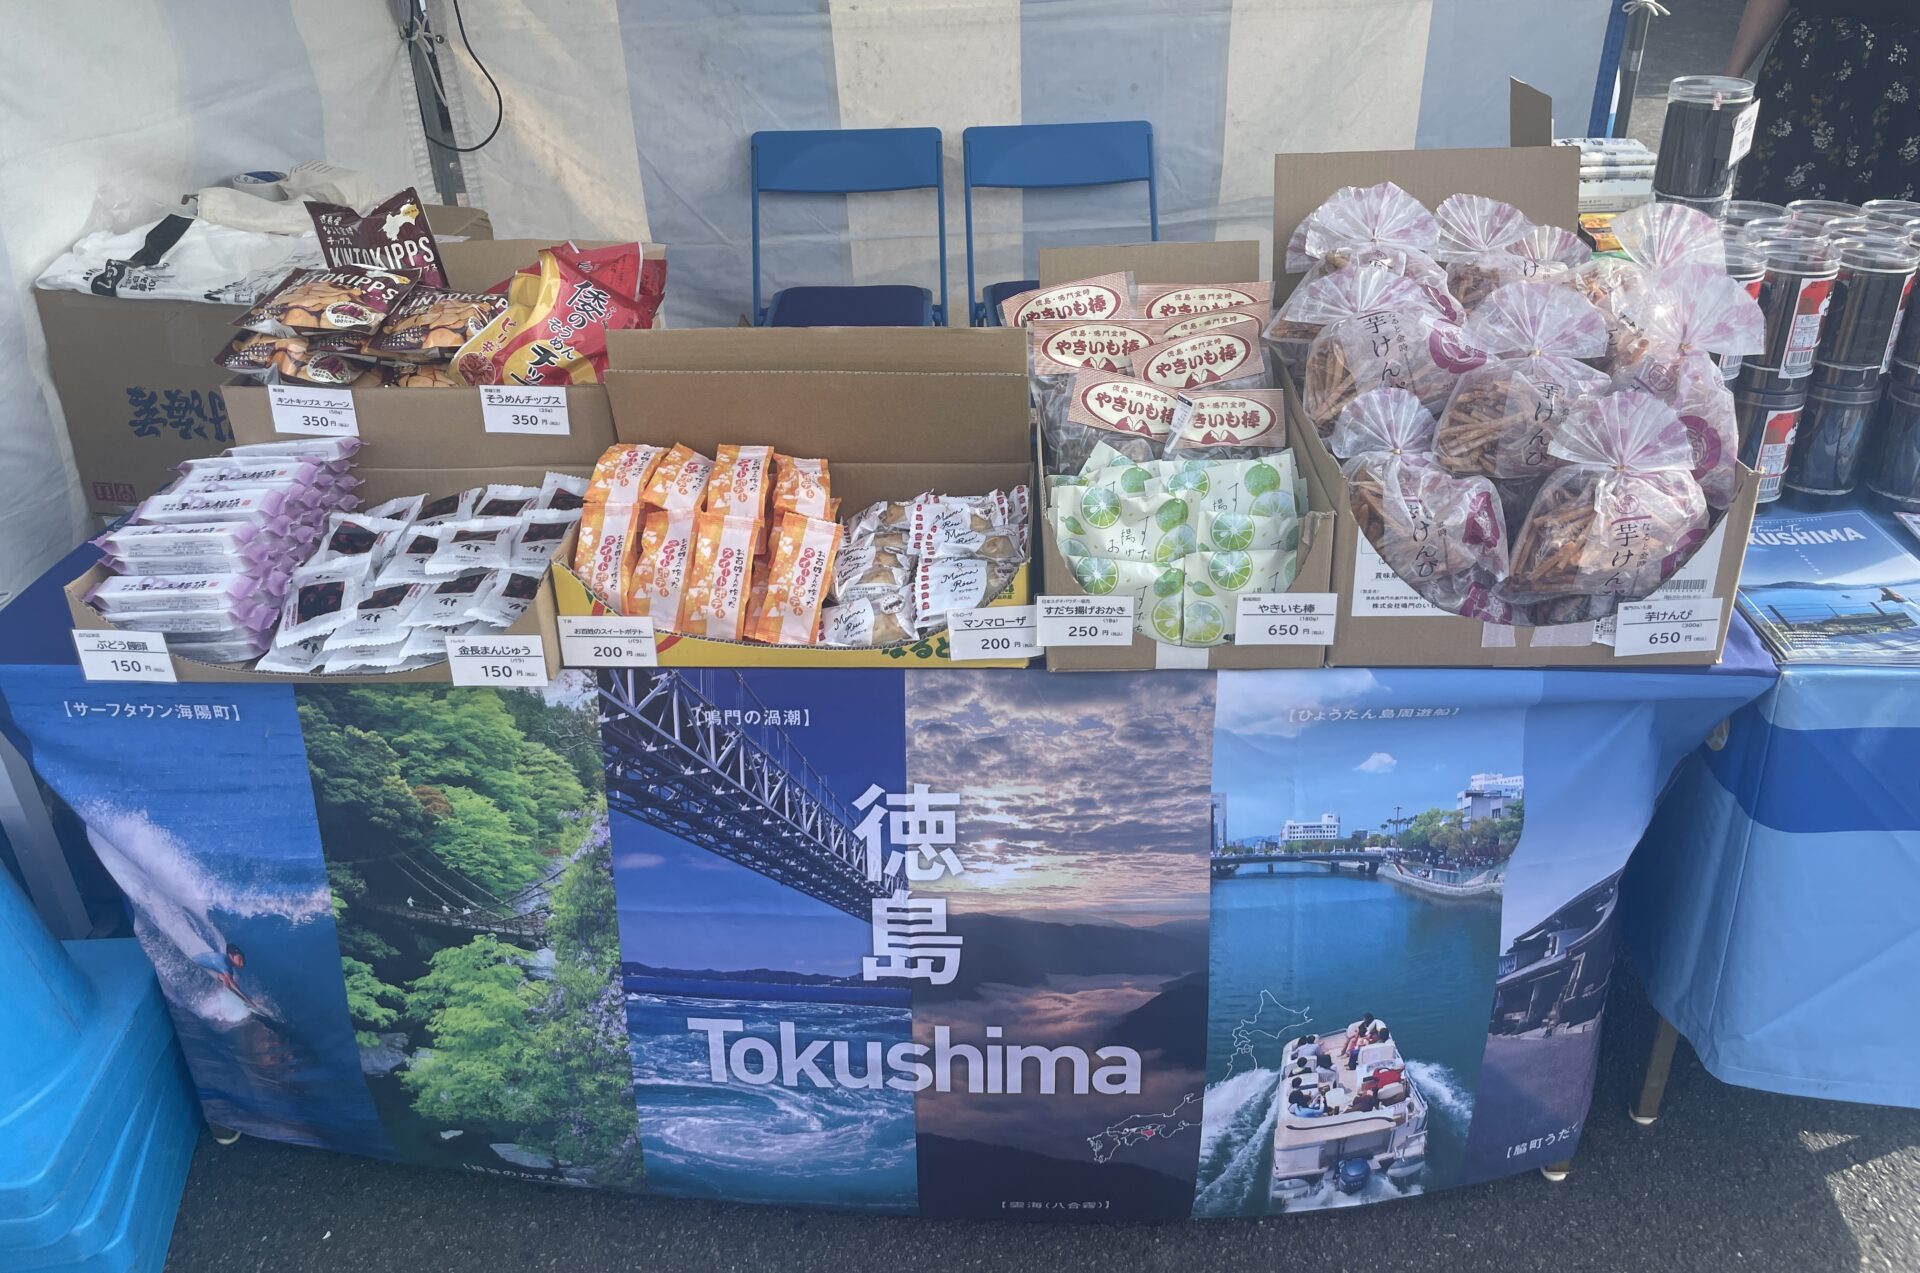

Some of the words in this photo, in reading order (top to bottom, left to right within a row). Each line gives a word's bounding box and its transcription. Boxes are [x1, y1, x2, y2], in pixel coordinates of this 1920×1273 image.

[1025, 294, 1107, 320] やきいも棒
[548, 317, 576, 360] そうめん
[1055, 339, 1140, 356] やきいも棒
[1362, 315, 1406, 389] 芋けん
[1155, 343, 1238, 378] やきいも棒
[277, 397, 321, 407] キントキップス
[486, 394, 562, 405] そうめんチップス
[1095, 392, 1176, 424] やきいも棒
[302, 415, 329, 427] 350
[511, 414, 538, 426] 350
[711, 547, 735, 619] スイートポテト
[789, 547, 816, 617] スイートポテト
[1044, 606, 1126, 615] すだち揚げおかき
[1258, 604, 1316, 614] やきいも棒
[963, 616, 1027, 628] マンマローザ
[1644, 610, 1693, 622] 芋けんぴ
[1068, 626, 1098, 637] 250
[1268, 624, 1299, 636] 650
[980, 637, 1010, 650] 200
[1648, 631, 1681, 645] 650
[97, 640, 148, 651] ぶどう饅頭
[458, 646, 531, 656] 金長まんじゅう
[593, 646, 623, 658] 200
[110, 659, 141, 673] 150
[481, 665, 513, 678] 150
[63, 700, 242, 722] 【サーフタウン海陽町】
[1288, 707, 1460, 723] 【ひょうたん島周遊船】
[694, 708, 811, 728] 【鳴門の渦潮】
[852, 783, 965, 985] 徳島
[687, 1017, 1142, 1096] Tokushima
